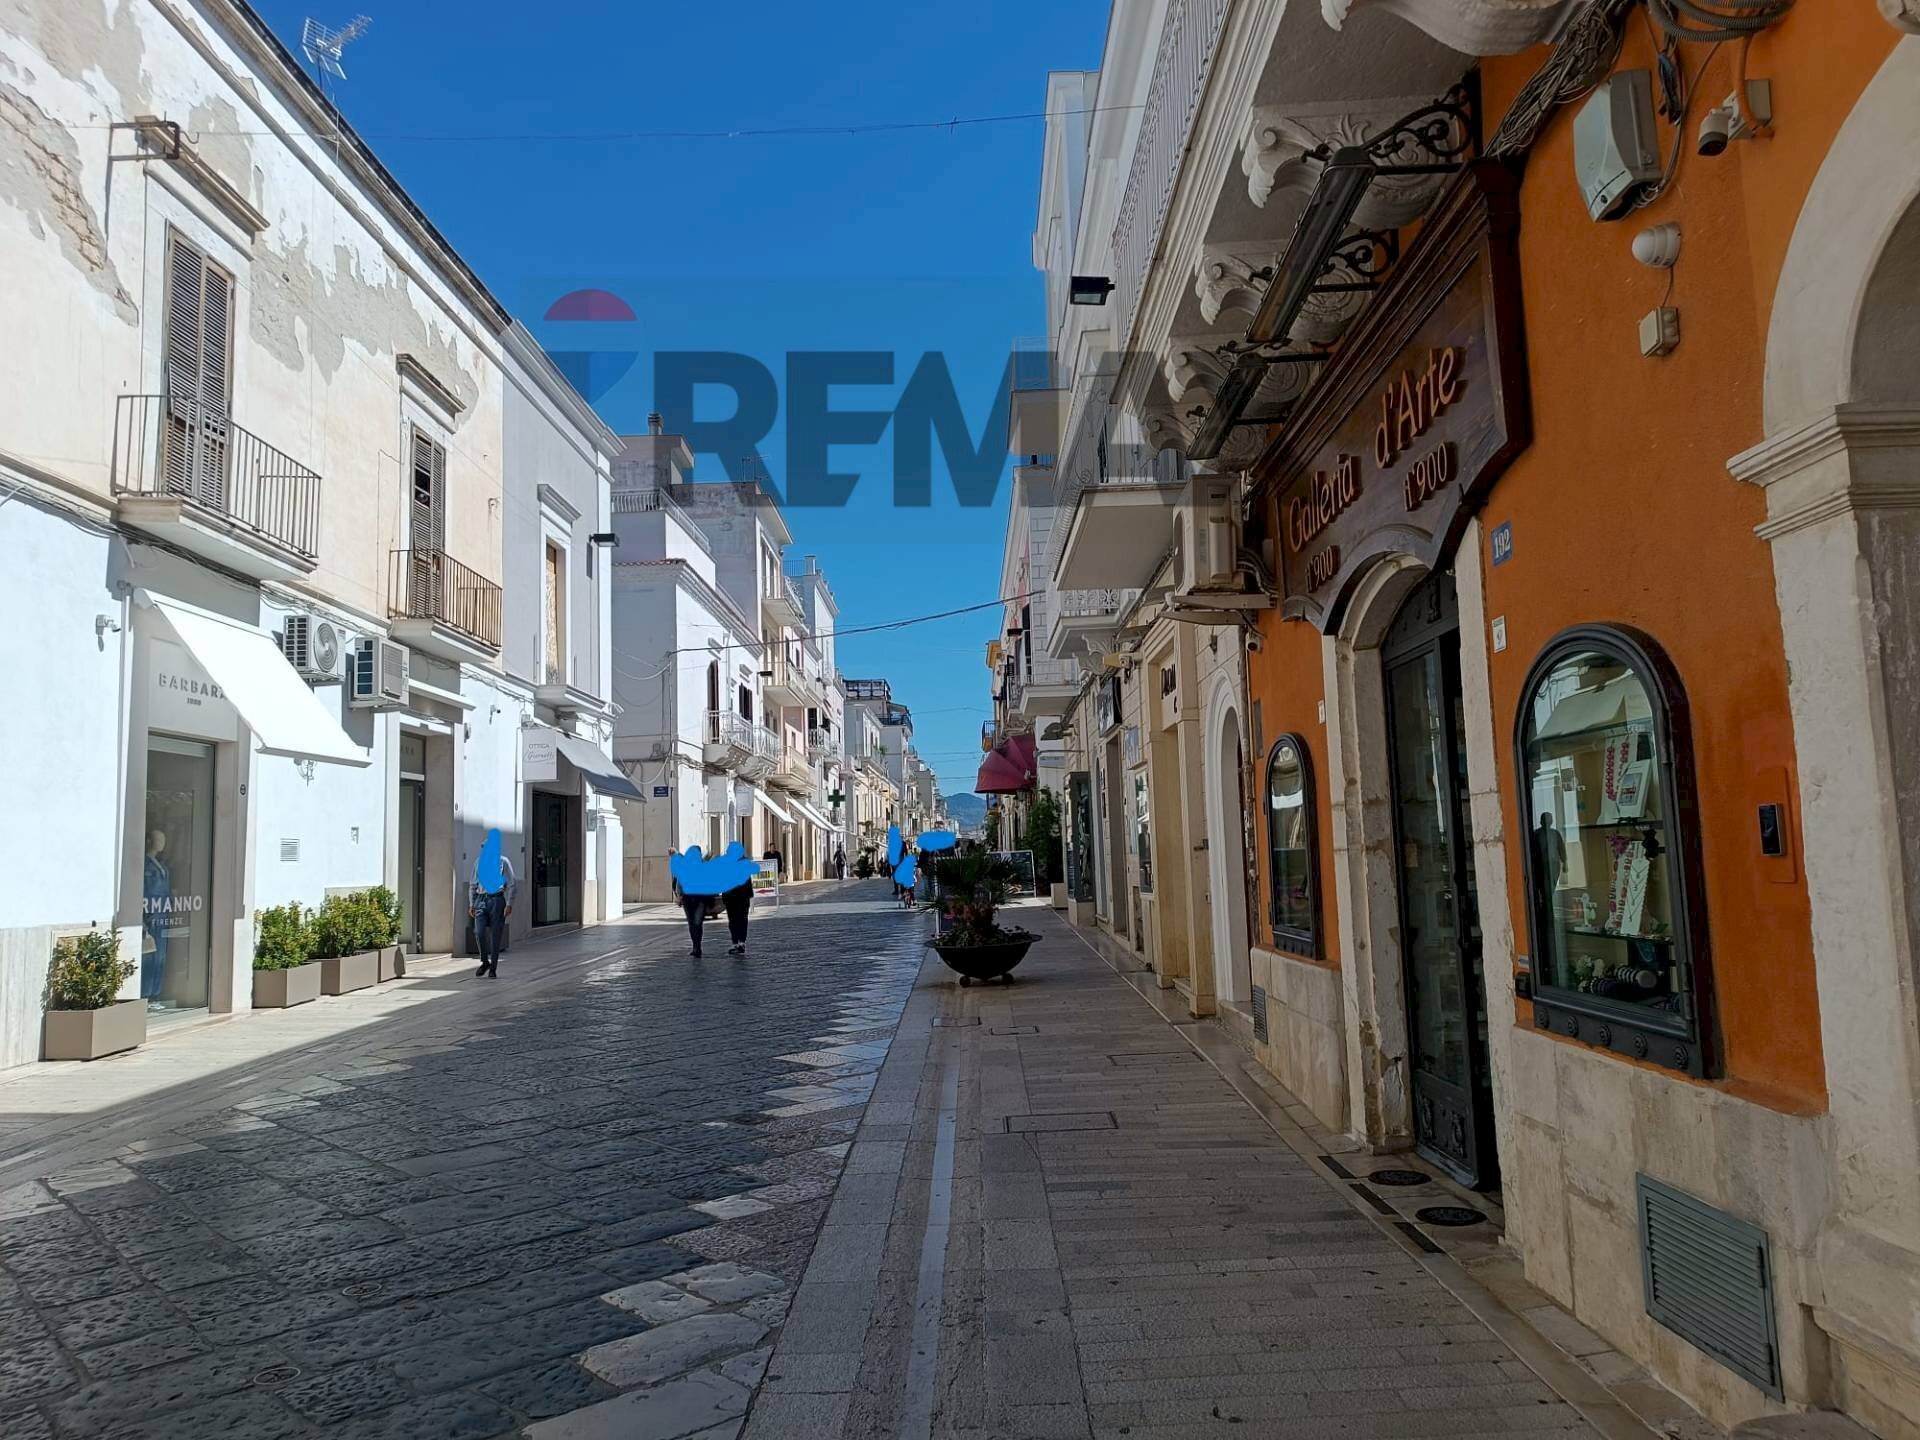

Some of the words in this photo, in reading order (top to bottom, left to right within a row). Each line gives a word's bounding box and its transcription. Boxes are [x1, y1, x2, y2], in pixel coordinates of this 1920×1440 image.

[1289, 454, 1354, 553] Galleria
[1375, 346, 1457, 469] d'Arte
[1493, 528, 1511, 559] 192
[151, 917, 184, 926] FIRENZE
